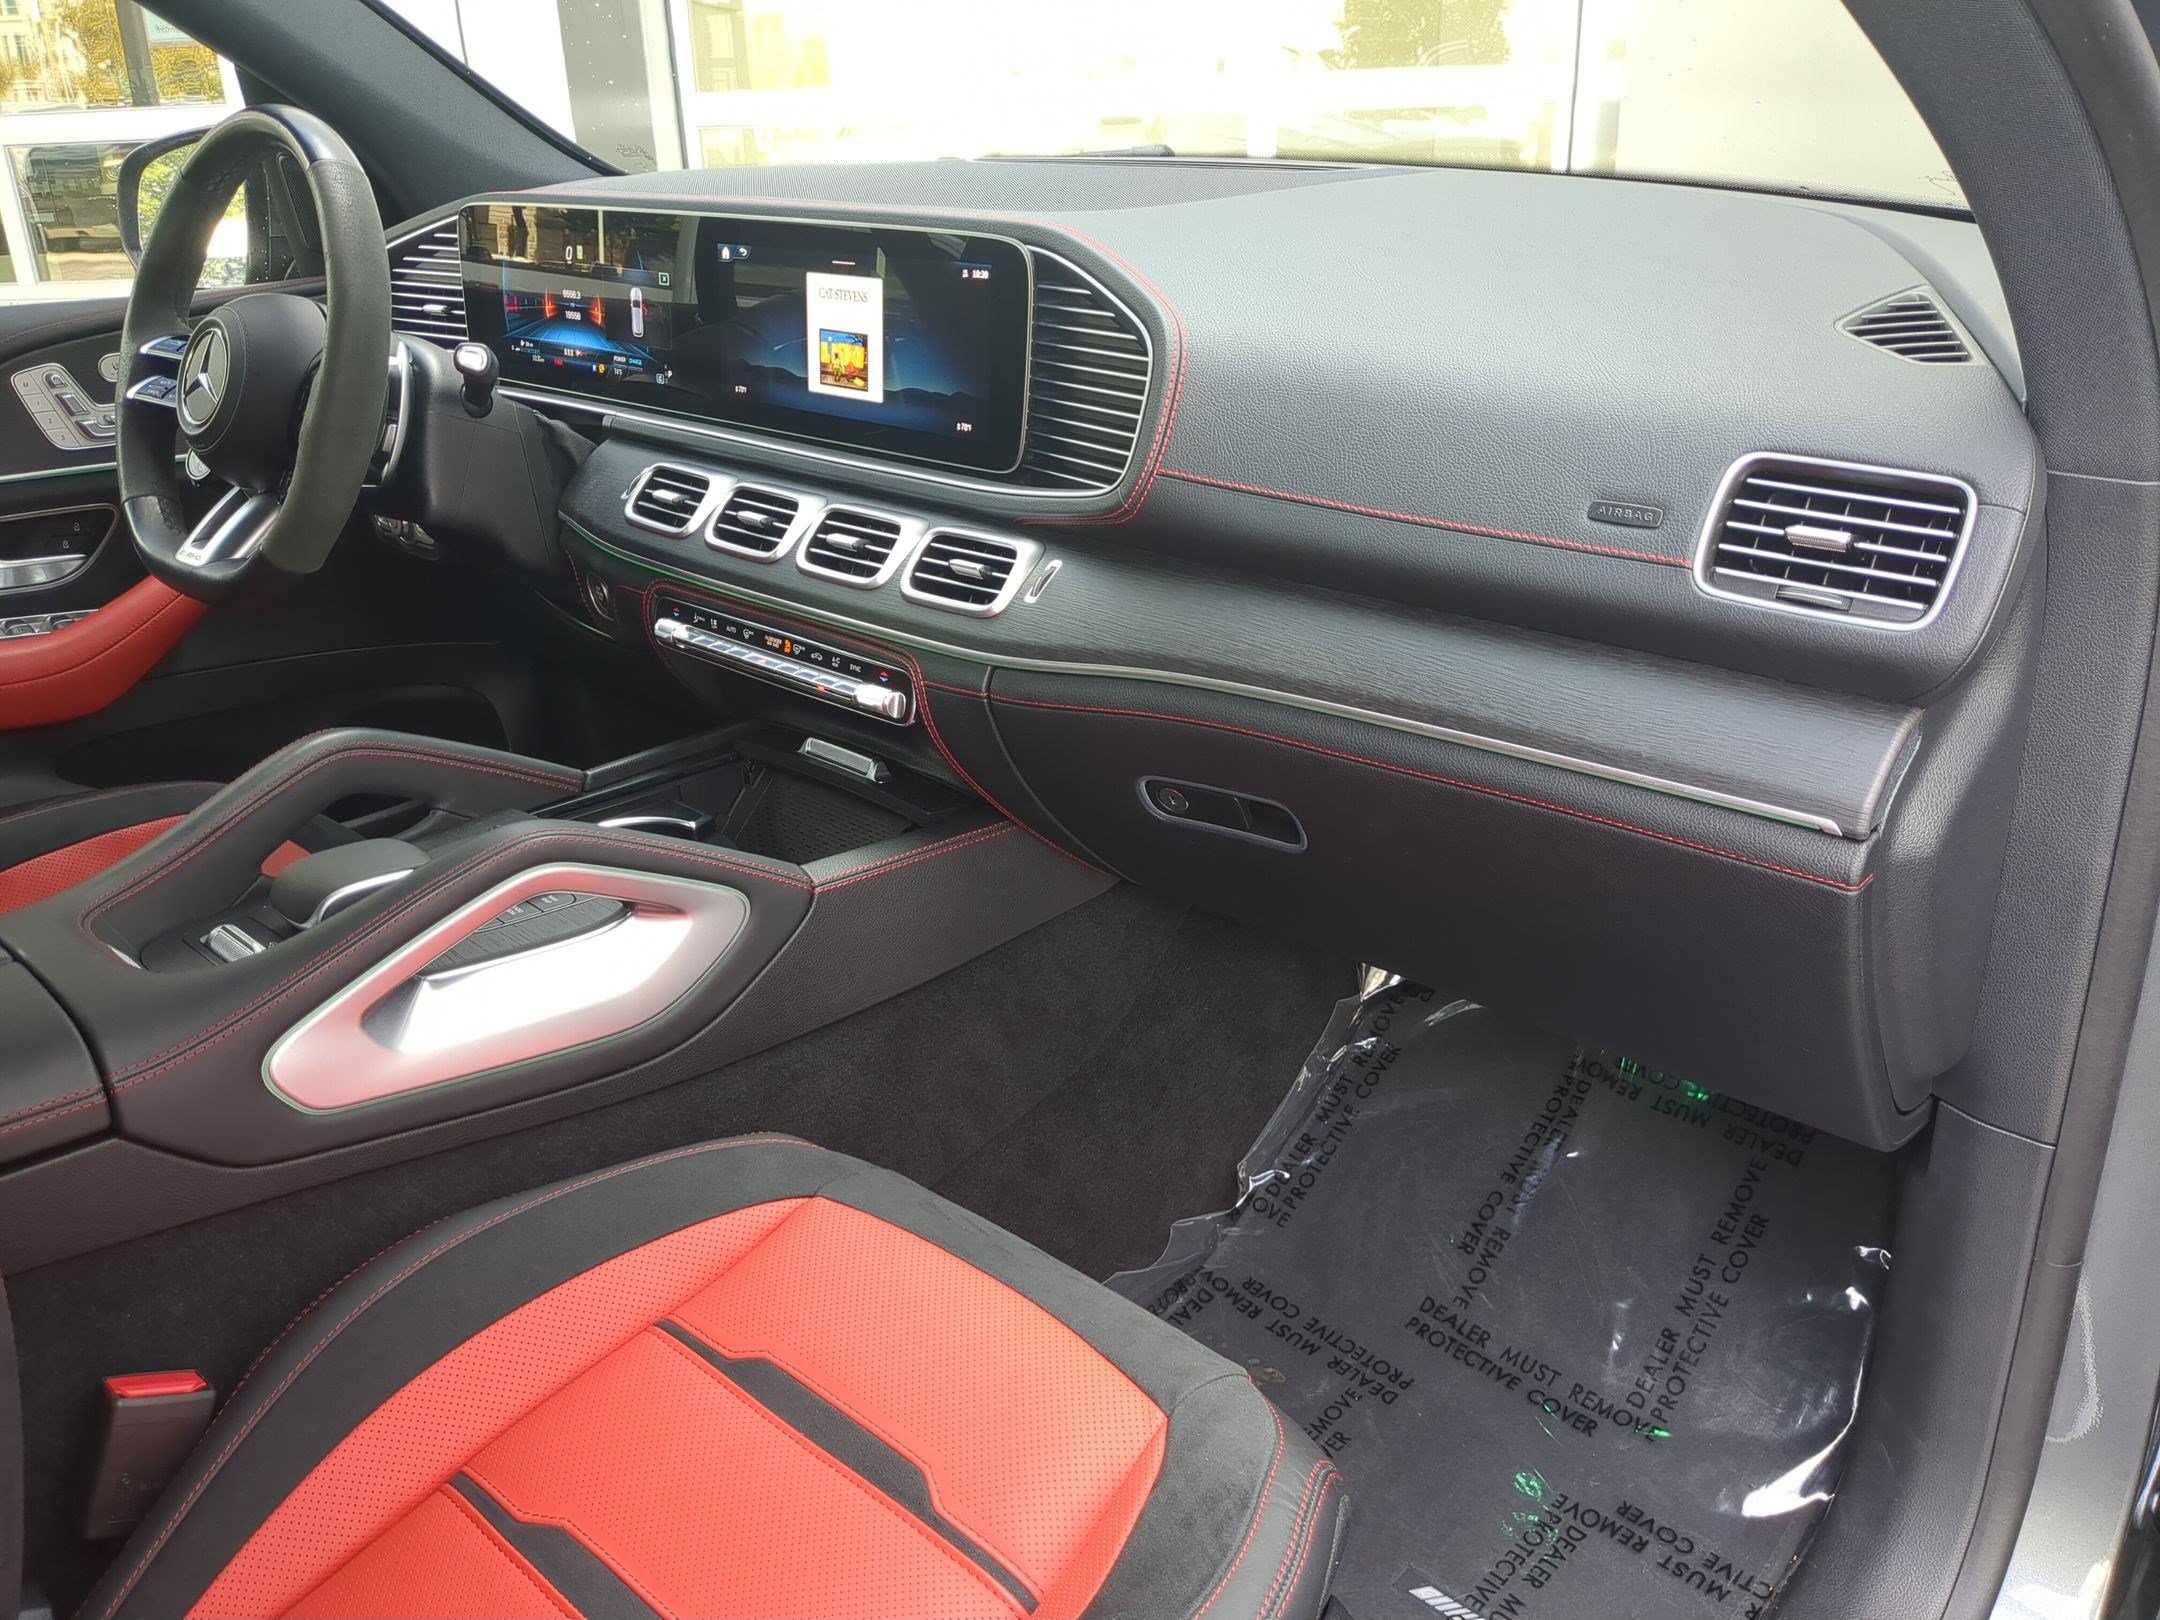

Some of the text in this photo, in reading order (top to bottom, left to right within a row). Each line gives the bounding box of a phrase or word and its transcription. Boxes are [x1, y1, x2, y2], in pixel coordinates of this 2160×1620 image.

[565, 245, 573, 261] 0
[819, 287, 868, 303] CAT STEVENS
[1598, 506, 1654, 521] AIRBAG
[726, 625, 737, 634] AUTO
[849, 663, 862, 673] SYNC
[1265, 1132, 1317, 1197] DEALER
[1315, 1073, 1354, 1123] MUST
[1282, 1042, 1402, 1210] PROTECTIVE COVER
[1501, 1073, 1575, 1185] PROTECTIVE
[1649, 1094, 1713, 1129] MUST
[1681, 1080, 1817, 1145] PROTECTI
[1722, 1123, 1804, 1167] DEALER
[1457, 1190, 1504, 1256] COVER
[1242, 1276, 1300, 1319] COVER
[1453, 1225, 1512, 1310] REMOVE
[1626, 1157, 1768, 1410] DEALER MUST REMOVE
[1265, 1319, 1321, 1356] MUST
[1651, 1212, 1770, 1424] PROTECTIVE COVER
[1303, 1316, 1414, 1391] PROTECTIVE
[1326, 1355, 1400, 1406] DEALER
[1404, 1316, 1599, 1438] PROTECTIVE COVER
[1418, 1296, 1656, 1443] DEALER MUST REMOVE
[1303, 1387, 1363, 1442] EMOVE
[1521, 1525, 1588, 1590] DEALER
[1551, 1492, 1732, 1602] MUST REMOVE
[1616, 1500, 1695, 1553] COVER
[1464, 1509, 1563, 1612] PROTECTIVE
